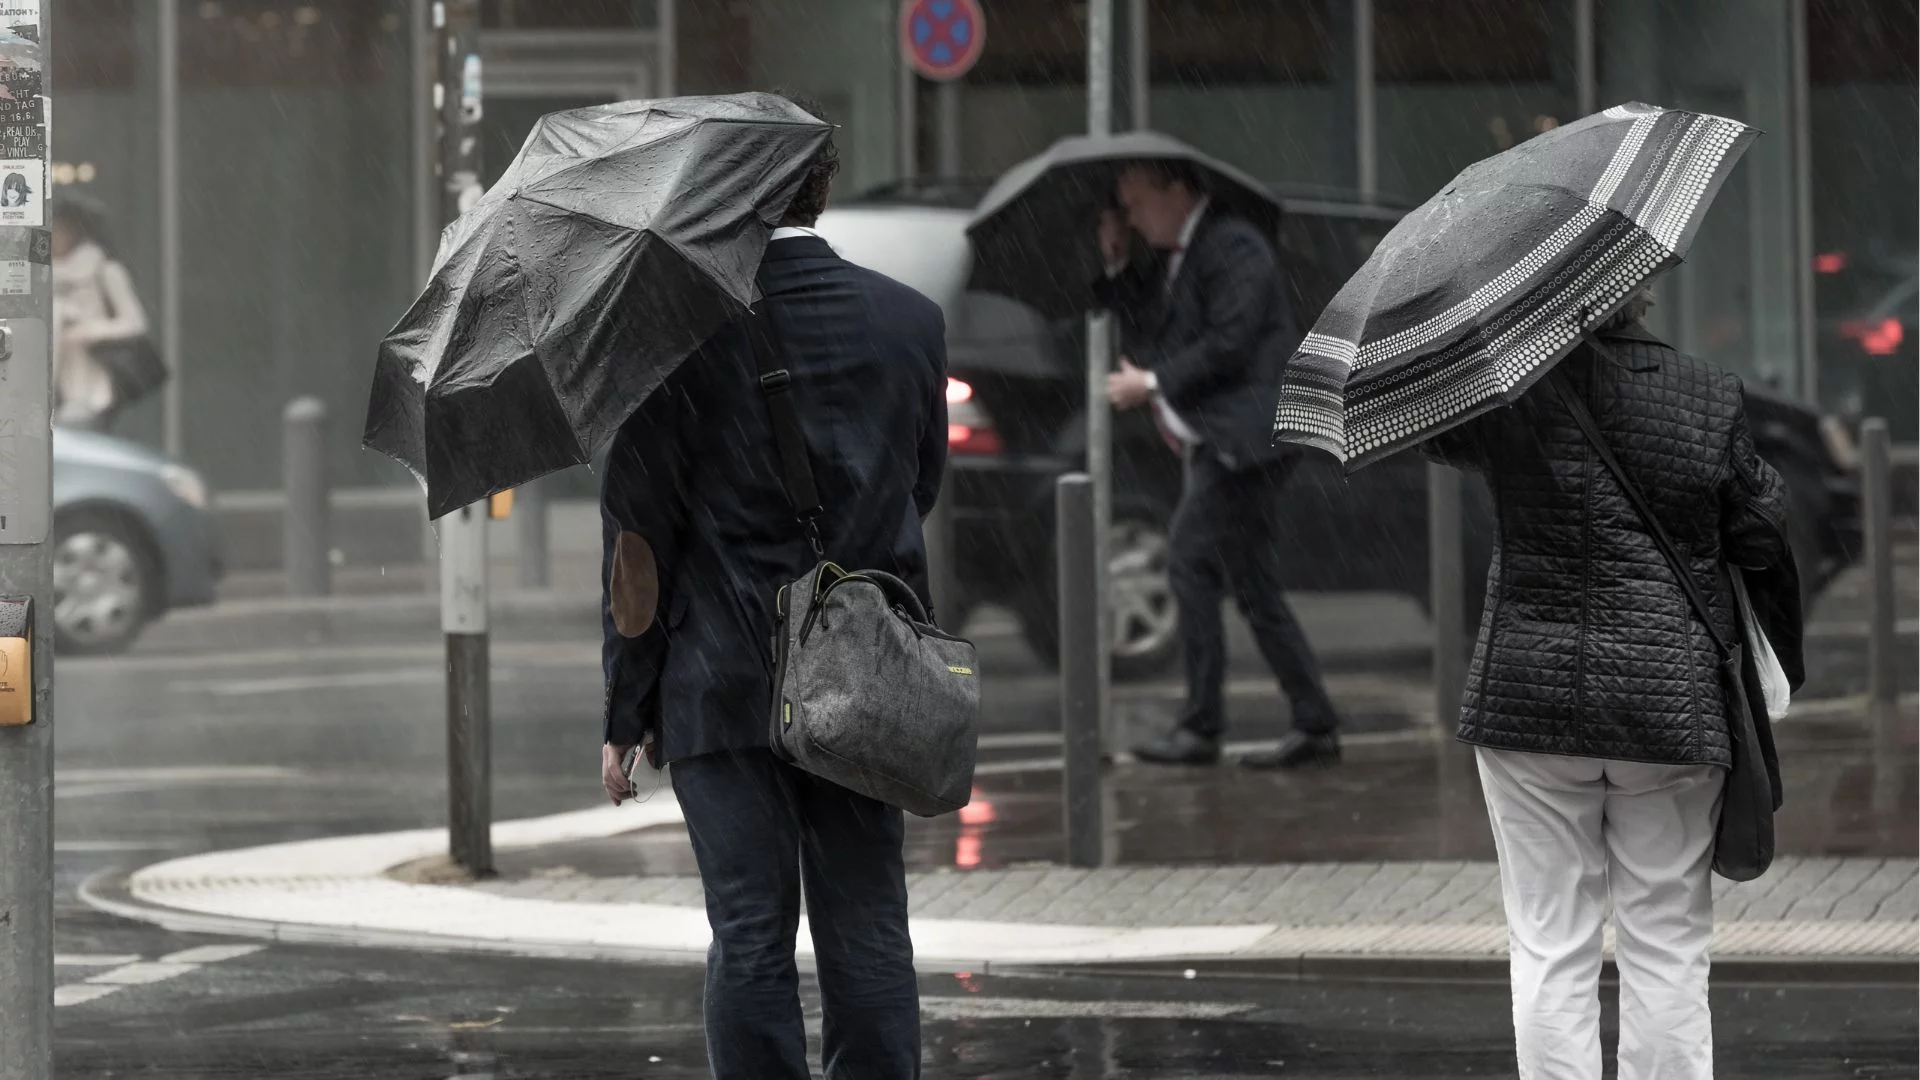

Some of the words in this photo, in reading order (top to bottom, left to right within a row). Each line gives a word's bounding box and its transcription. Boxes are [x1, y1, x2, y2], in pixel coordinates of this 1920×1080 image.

[15, 100, 35, 110] TAG
[7, 126, 24, 137] REAL
[14, 136, 30, 147] PLAY
[7, 147, 28, 158] VINYL
